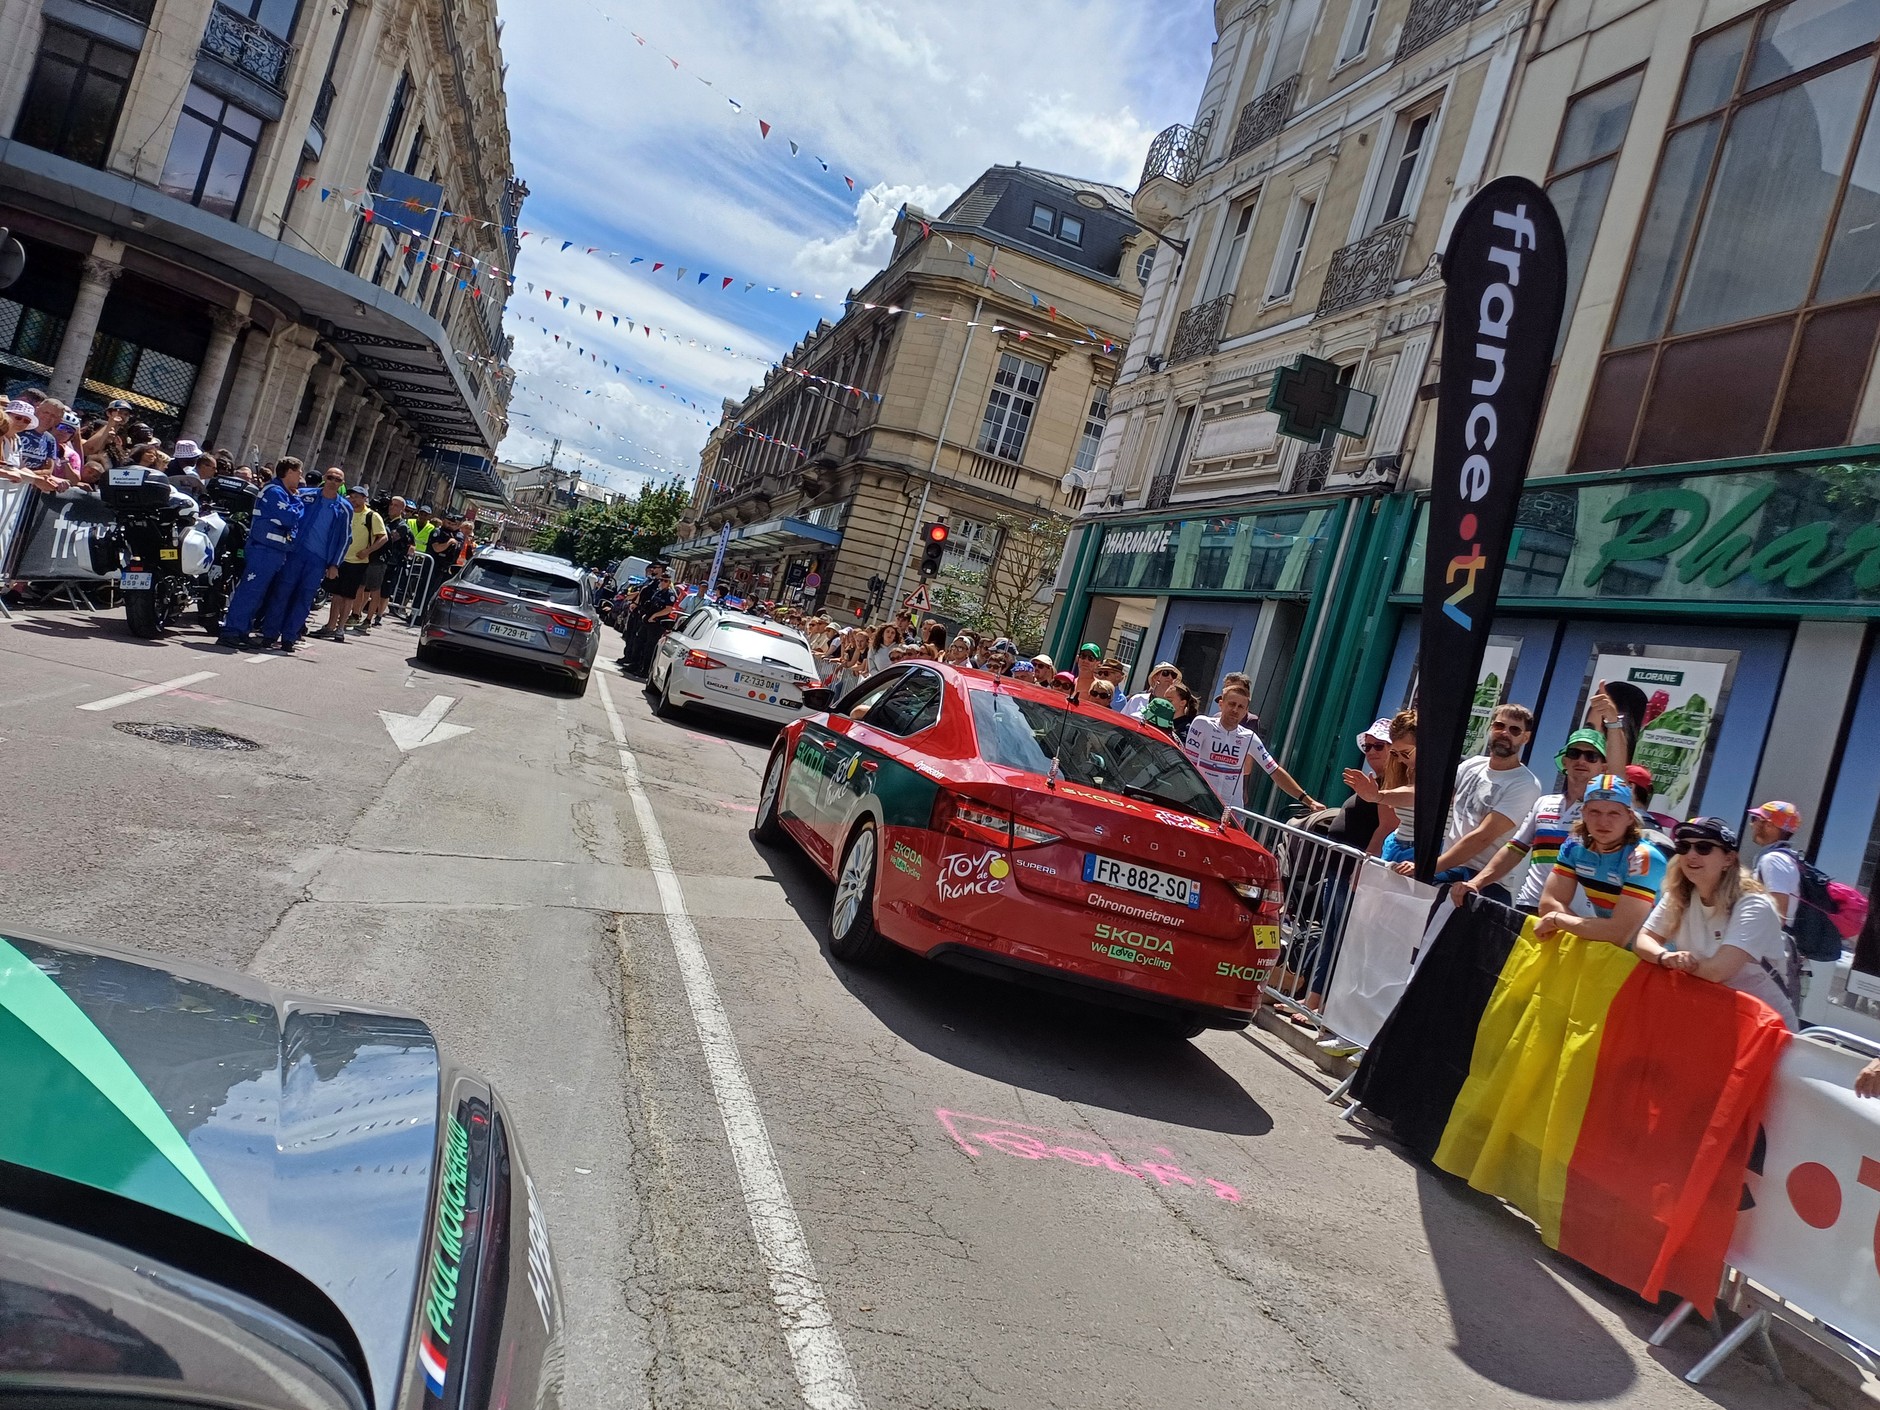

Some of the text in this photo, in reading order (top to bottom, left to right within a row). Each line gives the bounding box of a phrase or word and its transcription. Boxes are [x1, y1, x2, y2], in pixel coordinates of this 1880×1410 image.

[1100, 529, 1173, 555] PHARMACIE
[1633, 671, 1678, 683] KLORANE
[1210, 753, 1239, 764] Emirates
[1211, 741, 1241, 757] UAE
[976, 870, 989, 880] de
[1016, 859, 1057, 875] SUPERB
[936, 867, 1004, 903] france
[1097, 859, 1188, 900] FR-882-SQ
[1189, 893, 1199, 905] 92
[1087, 893, 1185, 927] Chronométreur
[1091, 941, 1172, 971] We Love Cycling
[426, 1112, 469, 1345] PAUL MOUCHERAUD
